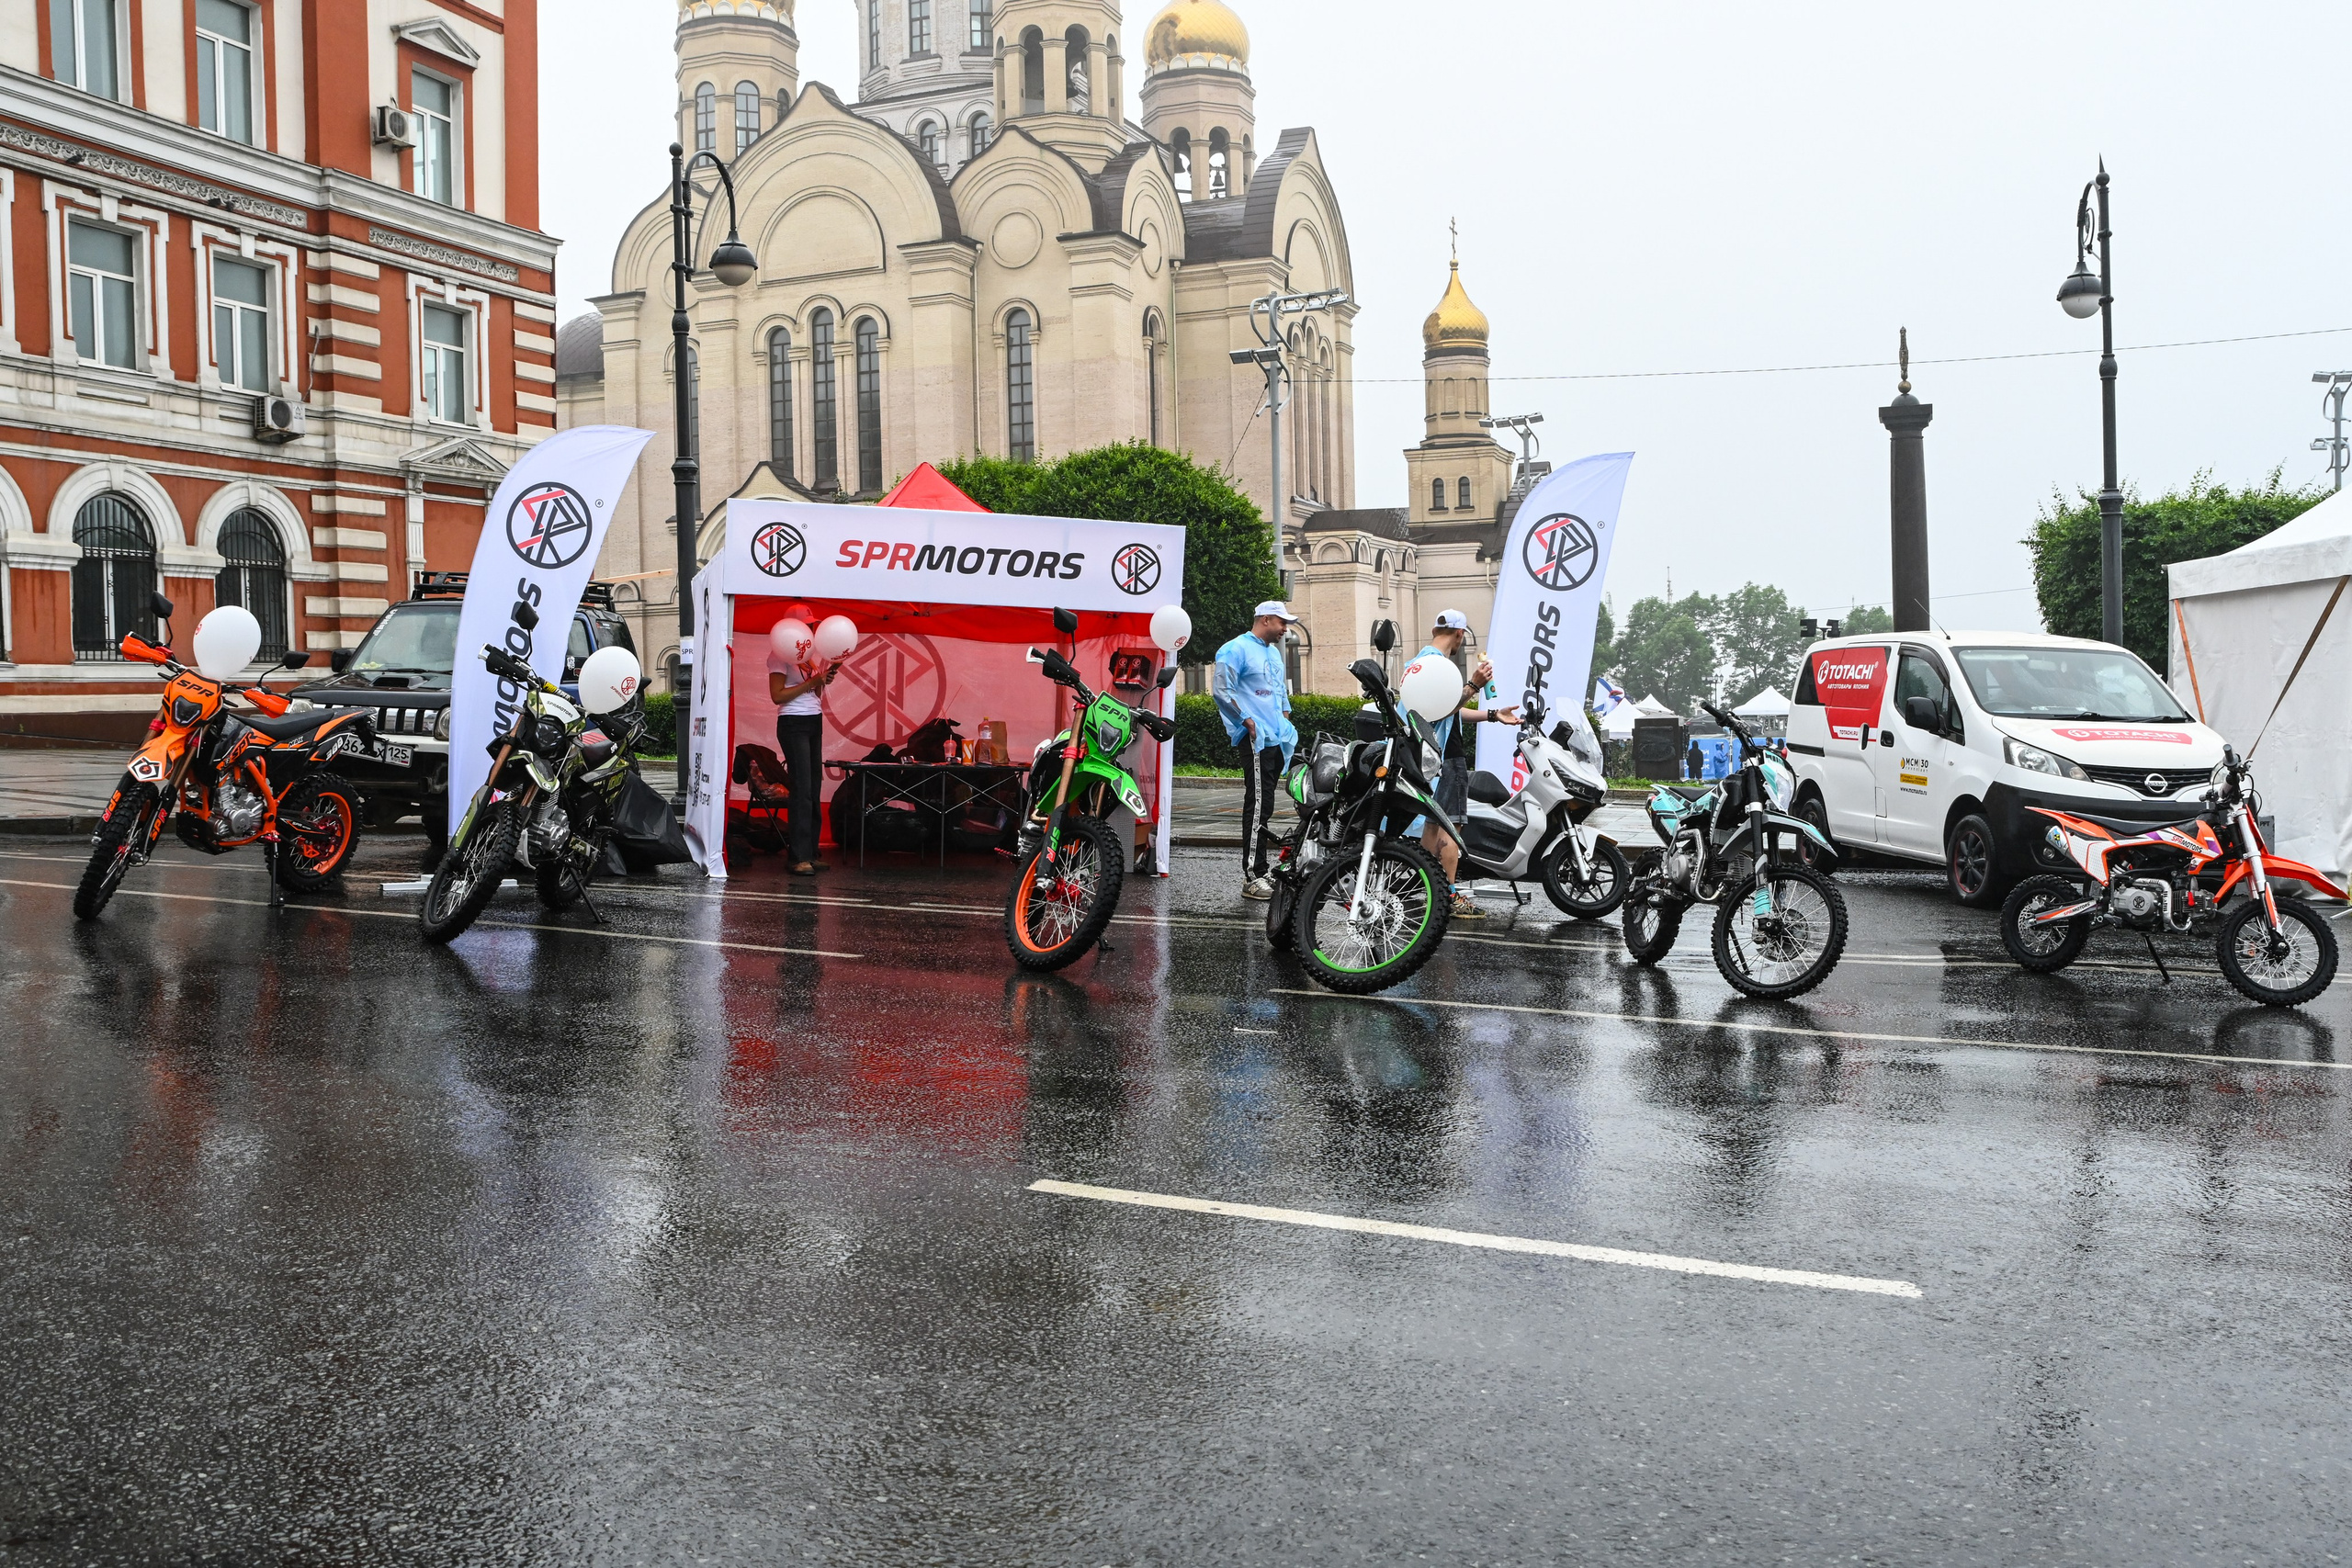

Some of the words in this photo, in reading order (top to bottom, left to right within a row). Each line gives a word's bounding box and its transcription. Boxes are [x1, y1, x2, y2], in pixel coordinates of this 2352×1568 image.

[835, 539, 1085, 581] SPRMOTORS
[1829, 664, 1874, 680] TOTACHI
[176, 680, 214, 697] SPR
[1099, 703, 1129, 723] SPR
[2088, 730, 2178, 739] TOTACHI
[388, 746, 407, 760] 125
[1920, 759, 1928, 768] 30
[102, 790, 121, 822] SPR
[150, 808, 167, 841] SPR
[1046, 826, 1061, 863] SPR
[2171, 835, 2203, 853] SPRMOTORS
[2064, 902, 2090, 916] SPRMOTORS
